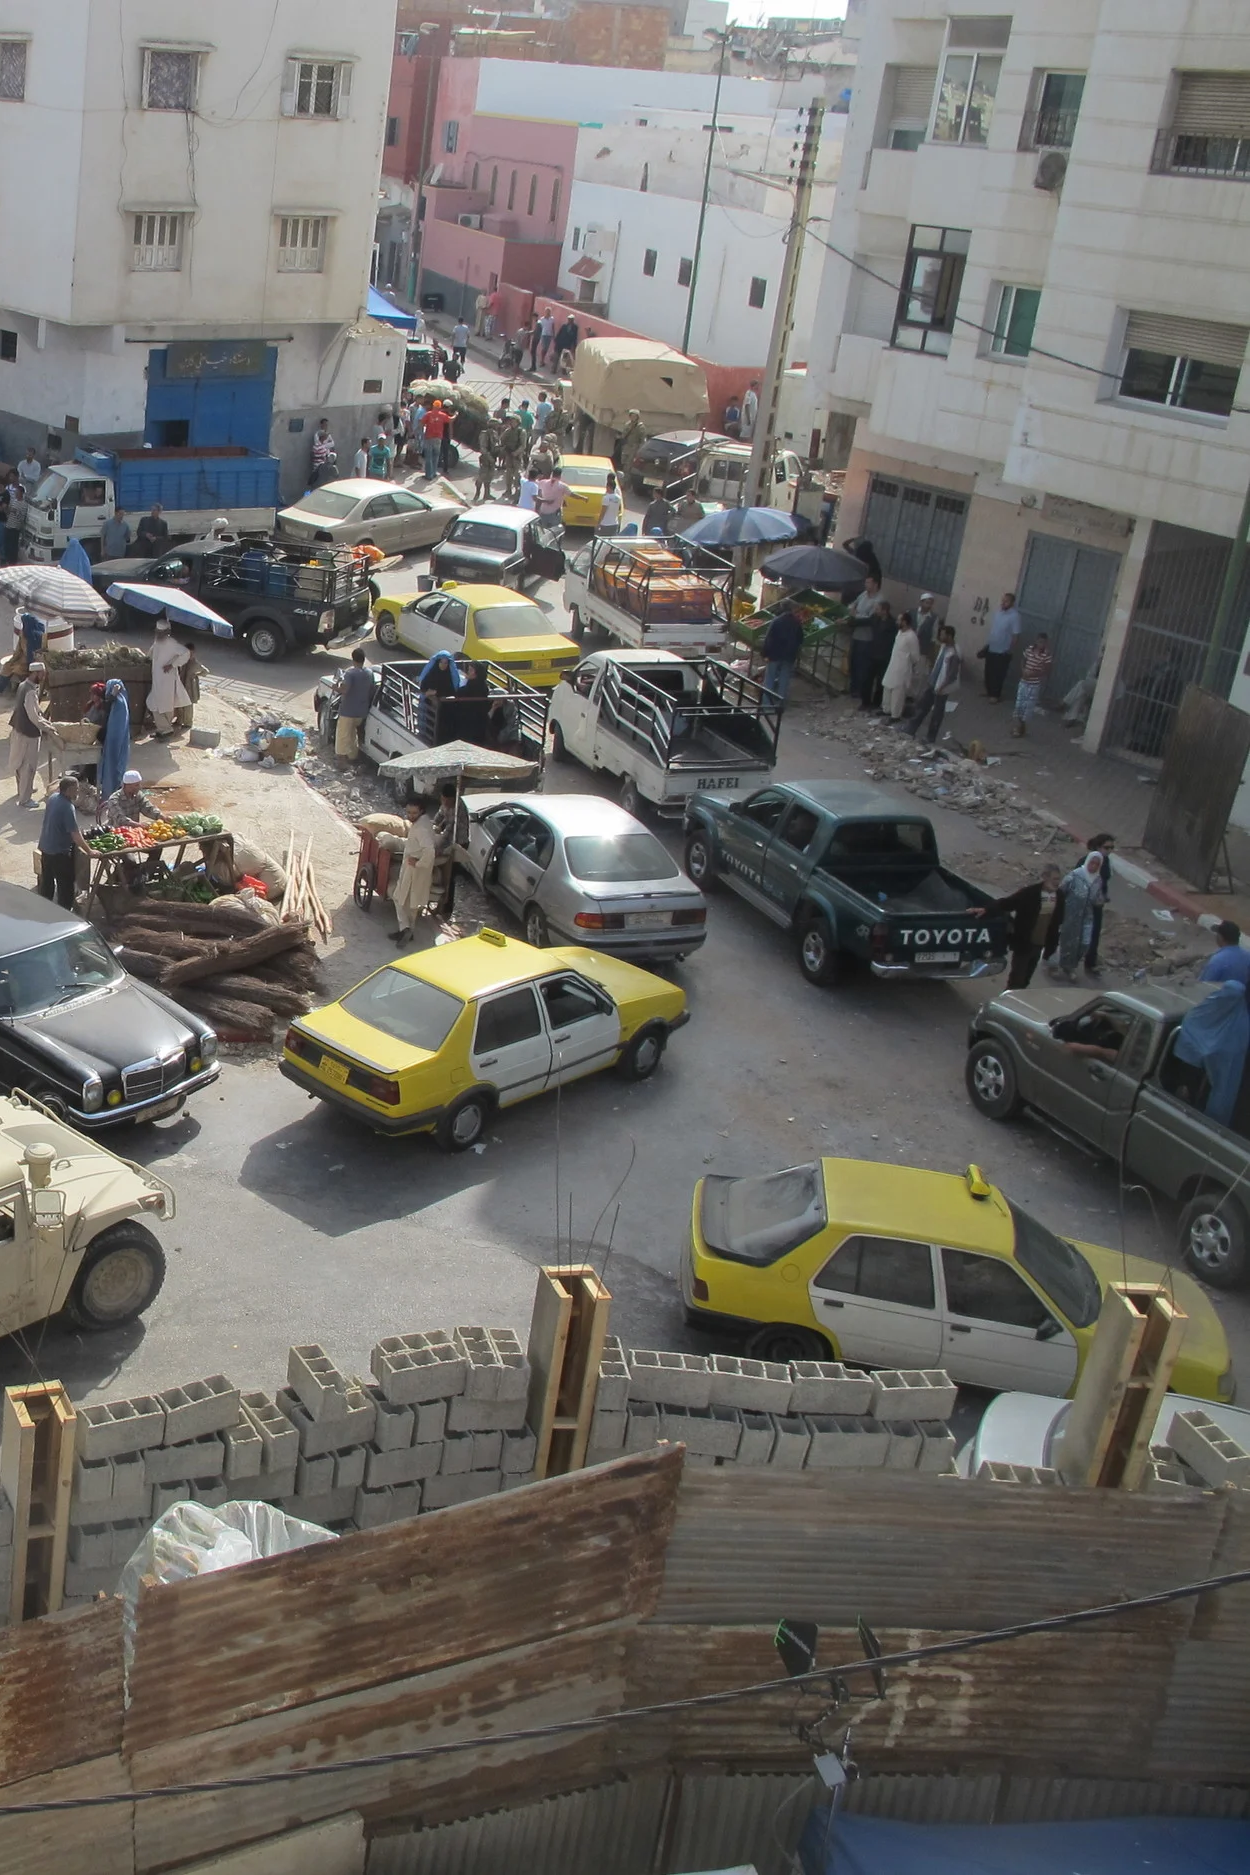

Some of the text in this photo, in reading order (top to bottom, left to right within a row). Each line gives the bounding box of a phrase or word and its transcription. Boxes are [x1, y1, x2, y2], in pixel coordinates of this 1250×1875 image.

[696, 777, 740, 790] HAFEI
[721, 849, 762, 884] TOYOTA
[900, 928, 991, 945] TOYOTA
